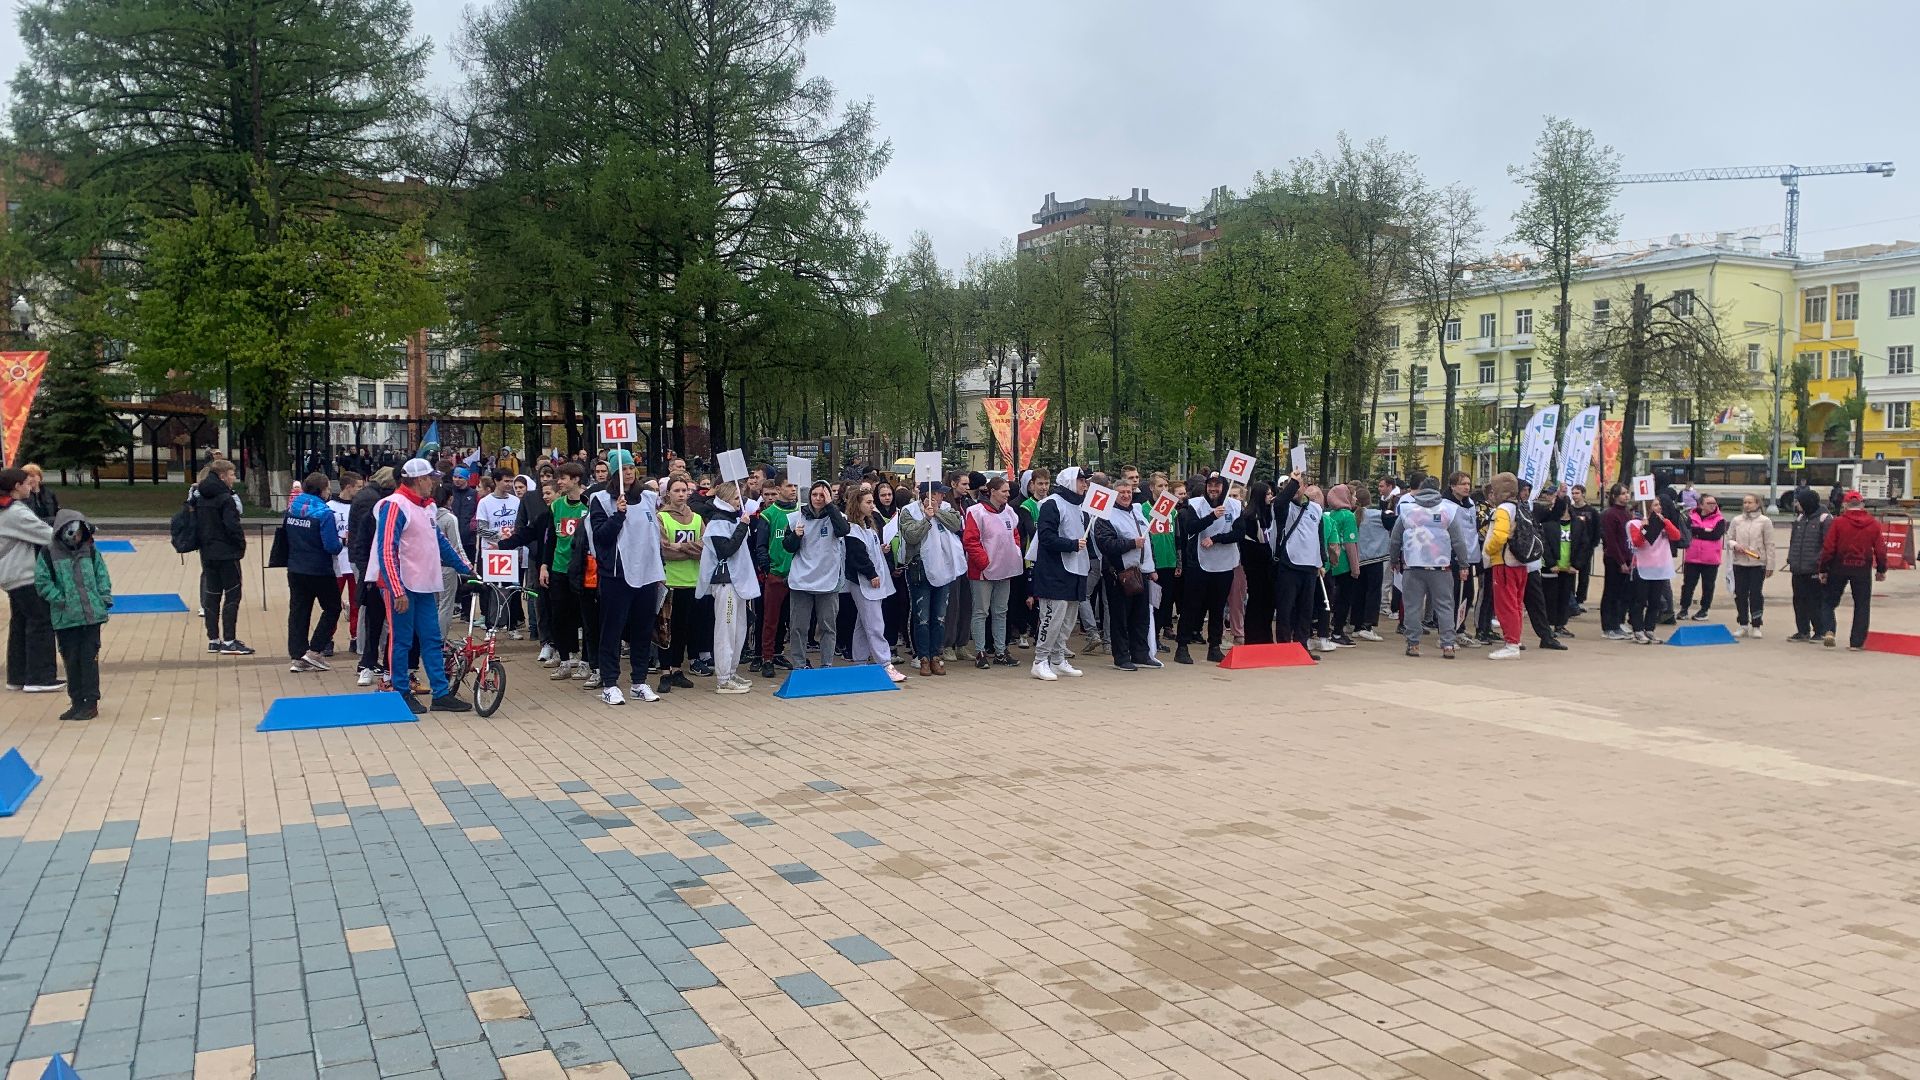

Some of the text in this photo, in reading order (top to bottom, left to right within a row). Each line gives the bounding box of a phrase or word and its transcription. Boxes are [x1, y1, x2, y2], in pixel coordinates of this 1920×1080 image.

[996, 400, 1009, 415] 9
[607, 419, 627, 438] 11
[1231, 459, 1245, 474] 5
[1641, 480, 1648, 494] 1
[1093, 491, 1107, 508] 7
[1159, 499, 1170, 513] 6
[286, 517, 311, 528] RUSSIA
[565, 519, 576, 535] 6
[1155, 519, 1165, 533] 6
[677, 530, 694, 543] 20
[1883, 540, 1901, 549] АРТ
[490, 555, 512, 575] 12
